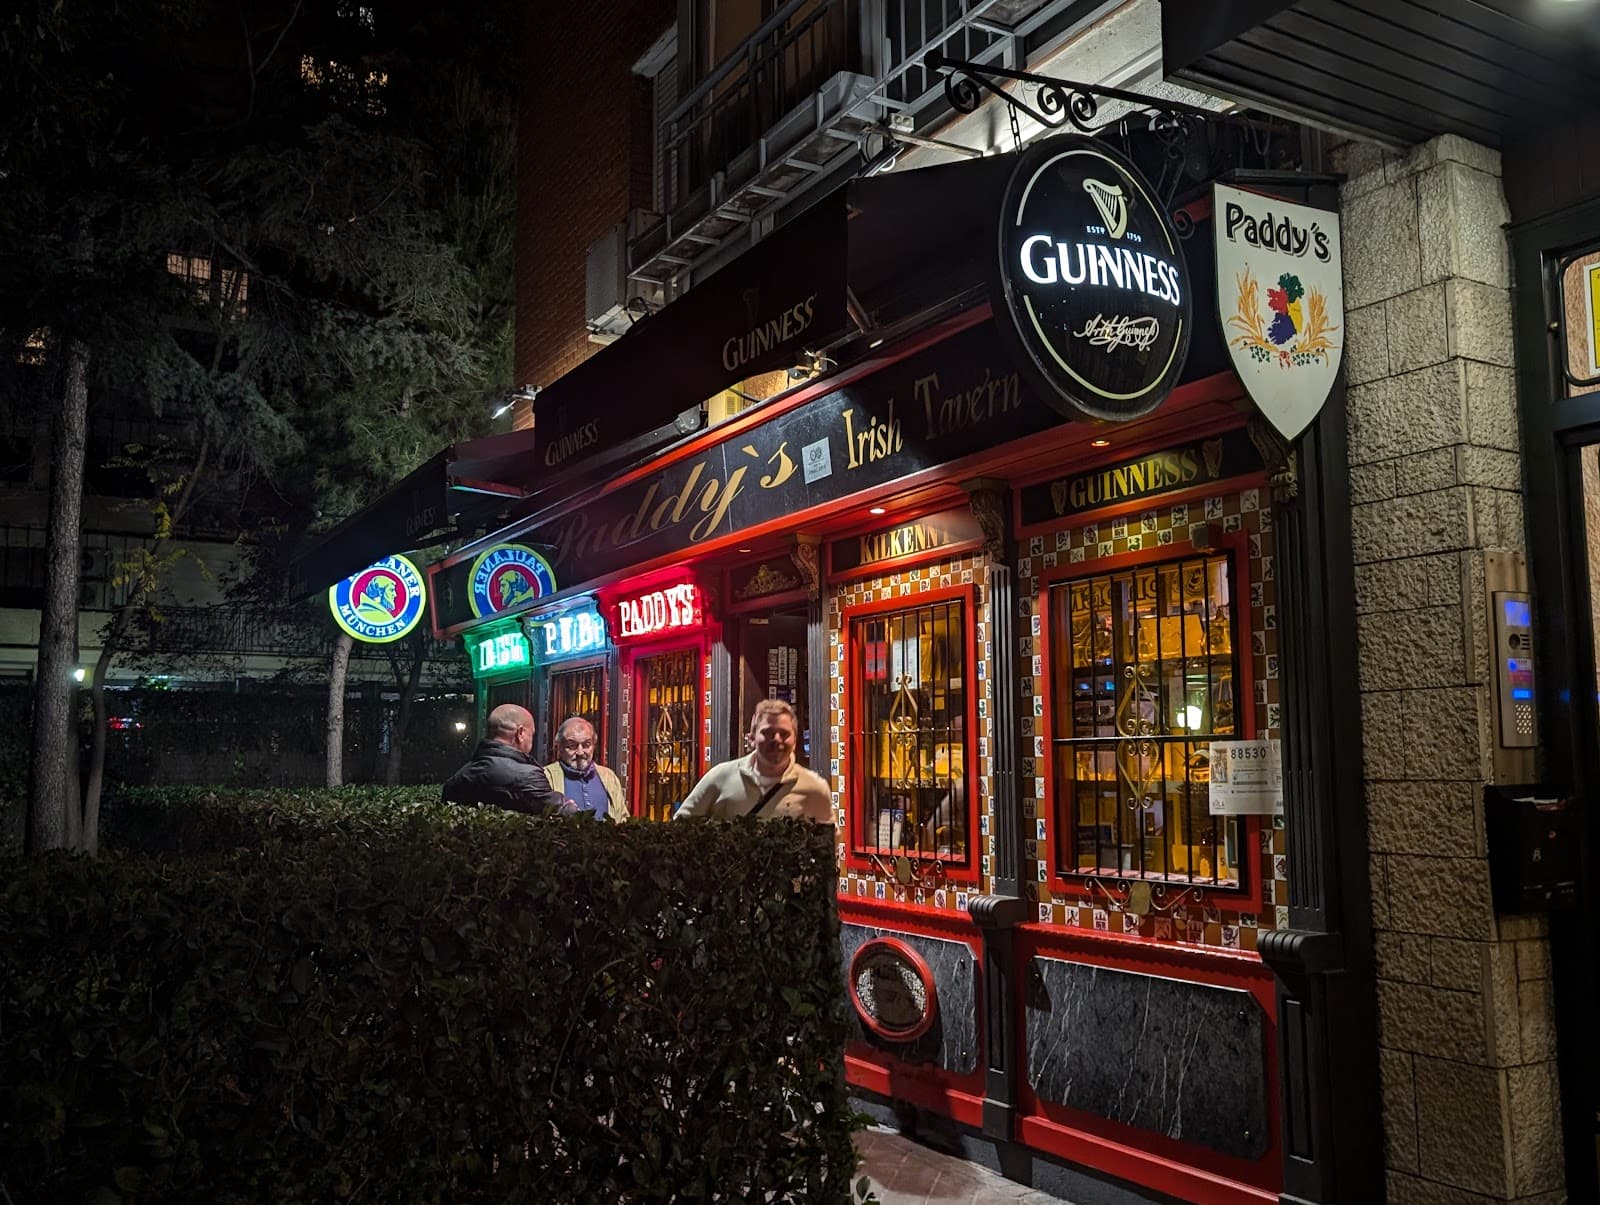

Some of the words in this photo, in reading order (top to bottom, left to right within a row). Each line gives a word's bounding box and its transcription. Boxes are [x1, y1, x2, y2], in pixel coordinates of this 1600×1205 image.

[1126, 232, 1142, 242] 1759
[1226, 203, 1331, 263] Paddy's
[1020, 235, 1181, 307] GUINNESS
[722, 295, 814, 372] GUINNESS
[545, 417, 599, 467] GUINNESS
[842, 397, 903, 470] Irish
[914, 367, 1022, 441] Tavern
[1070, 449, 1198, 508] GUINNESS
[1231, 747, 1267, 760] 88530
